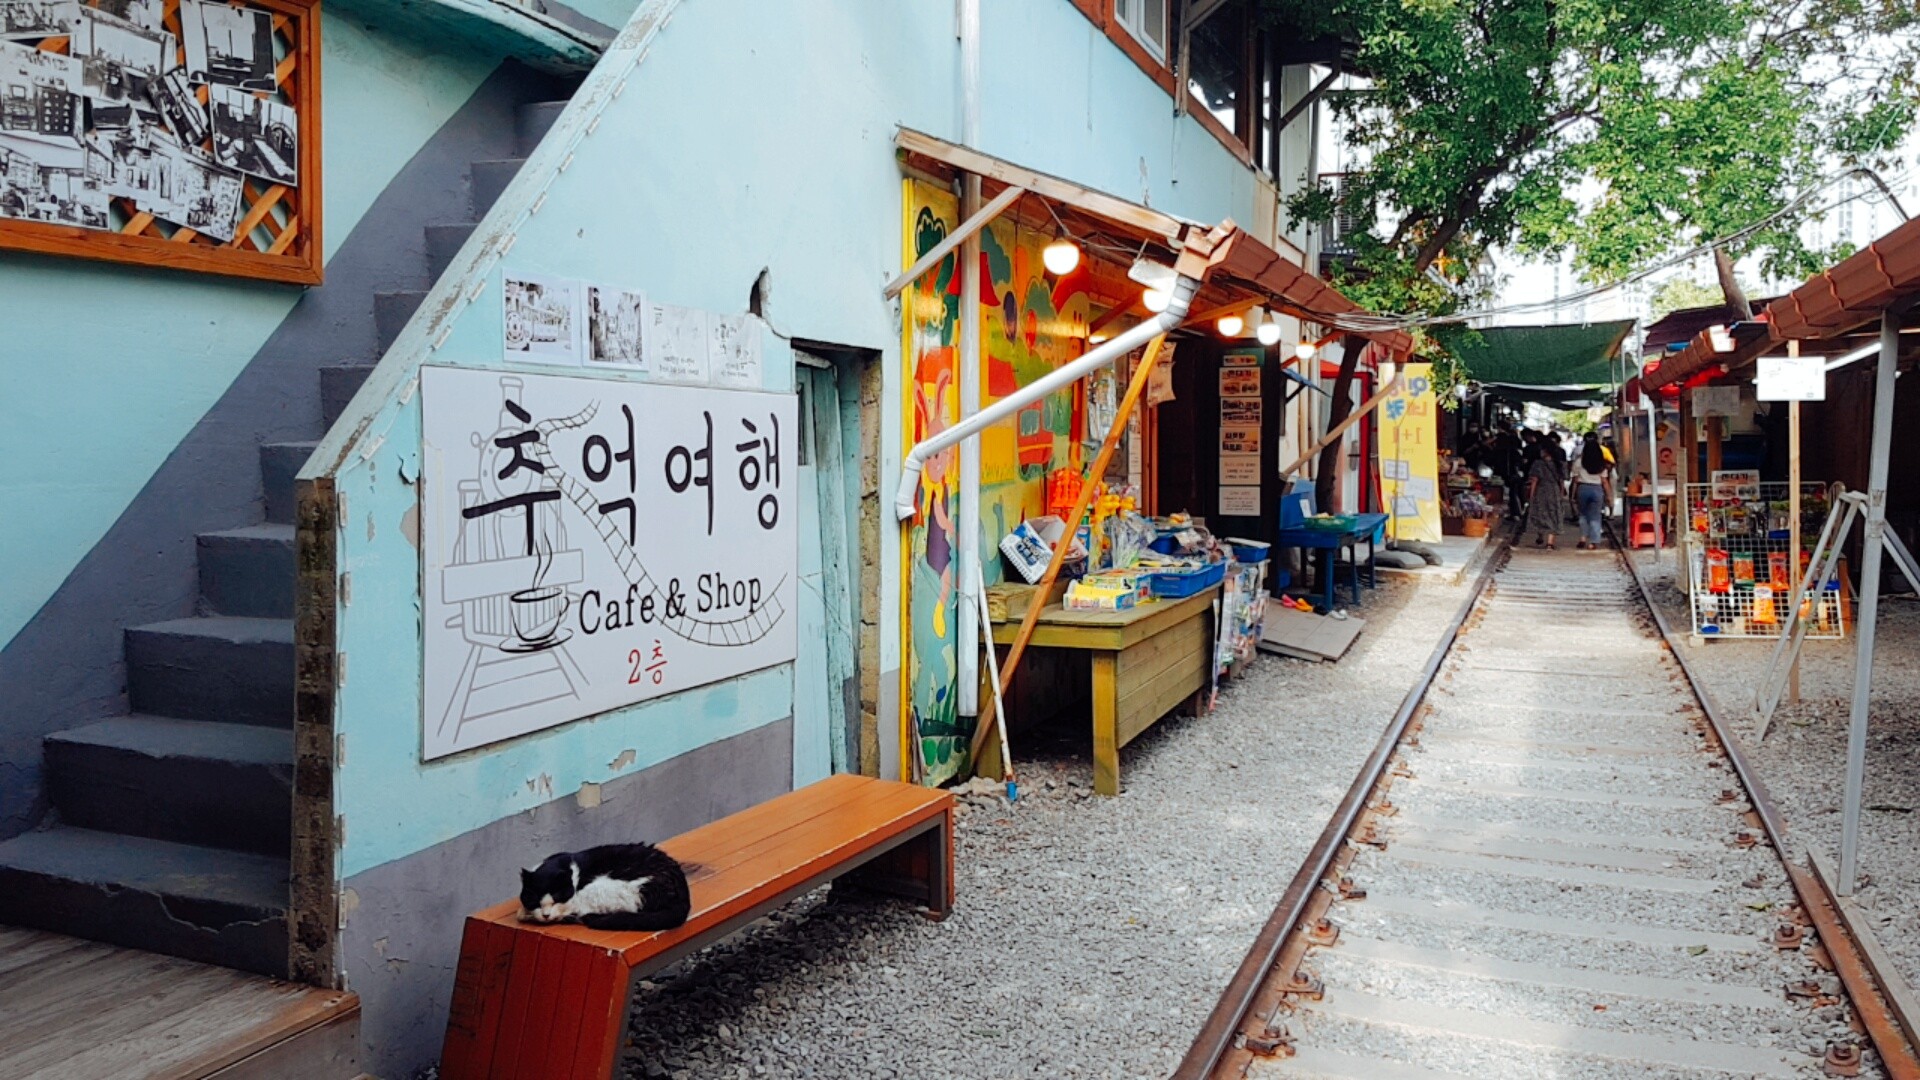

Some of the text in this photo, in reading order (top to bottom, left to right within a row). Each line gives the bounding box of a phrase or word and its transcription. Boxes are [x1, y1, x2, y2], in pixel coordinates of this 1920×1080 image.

[462, 399, 781, 556] 추억여행
[579, 571, 761, 635] Cafe & Shop
[628, 639, 668, 685] 2층
